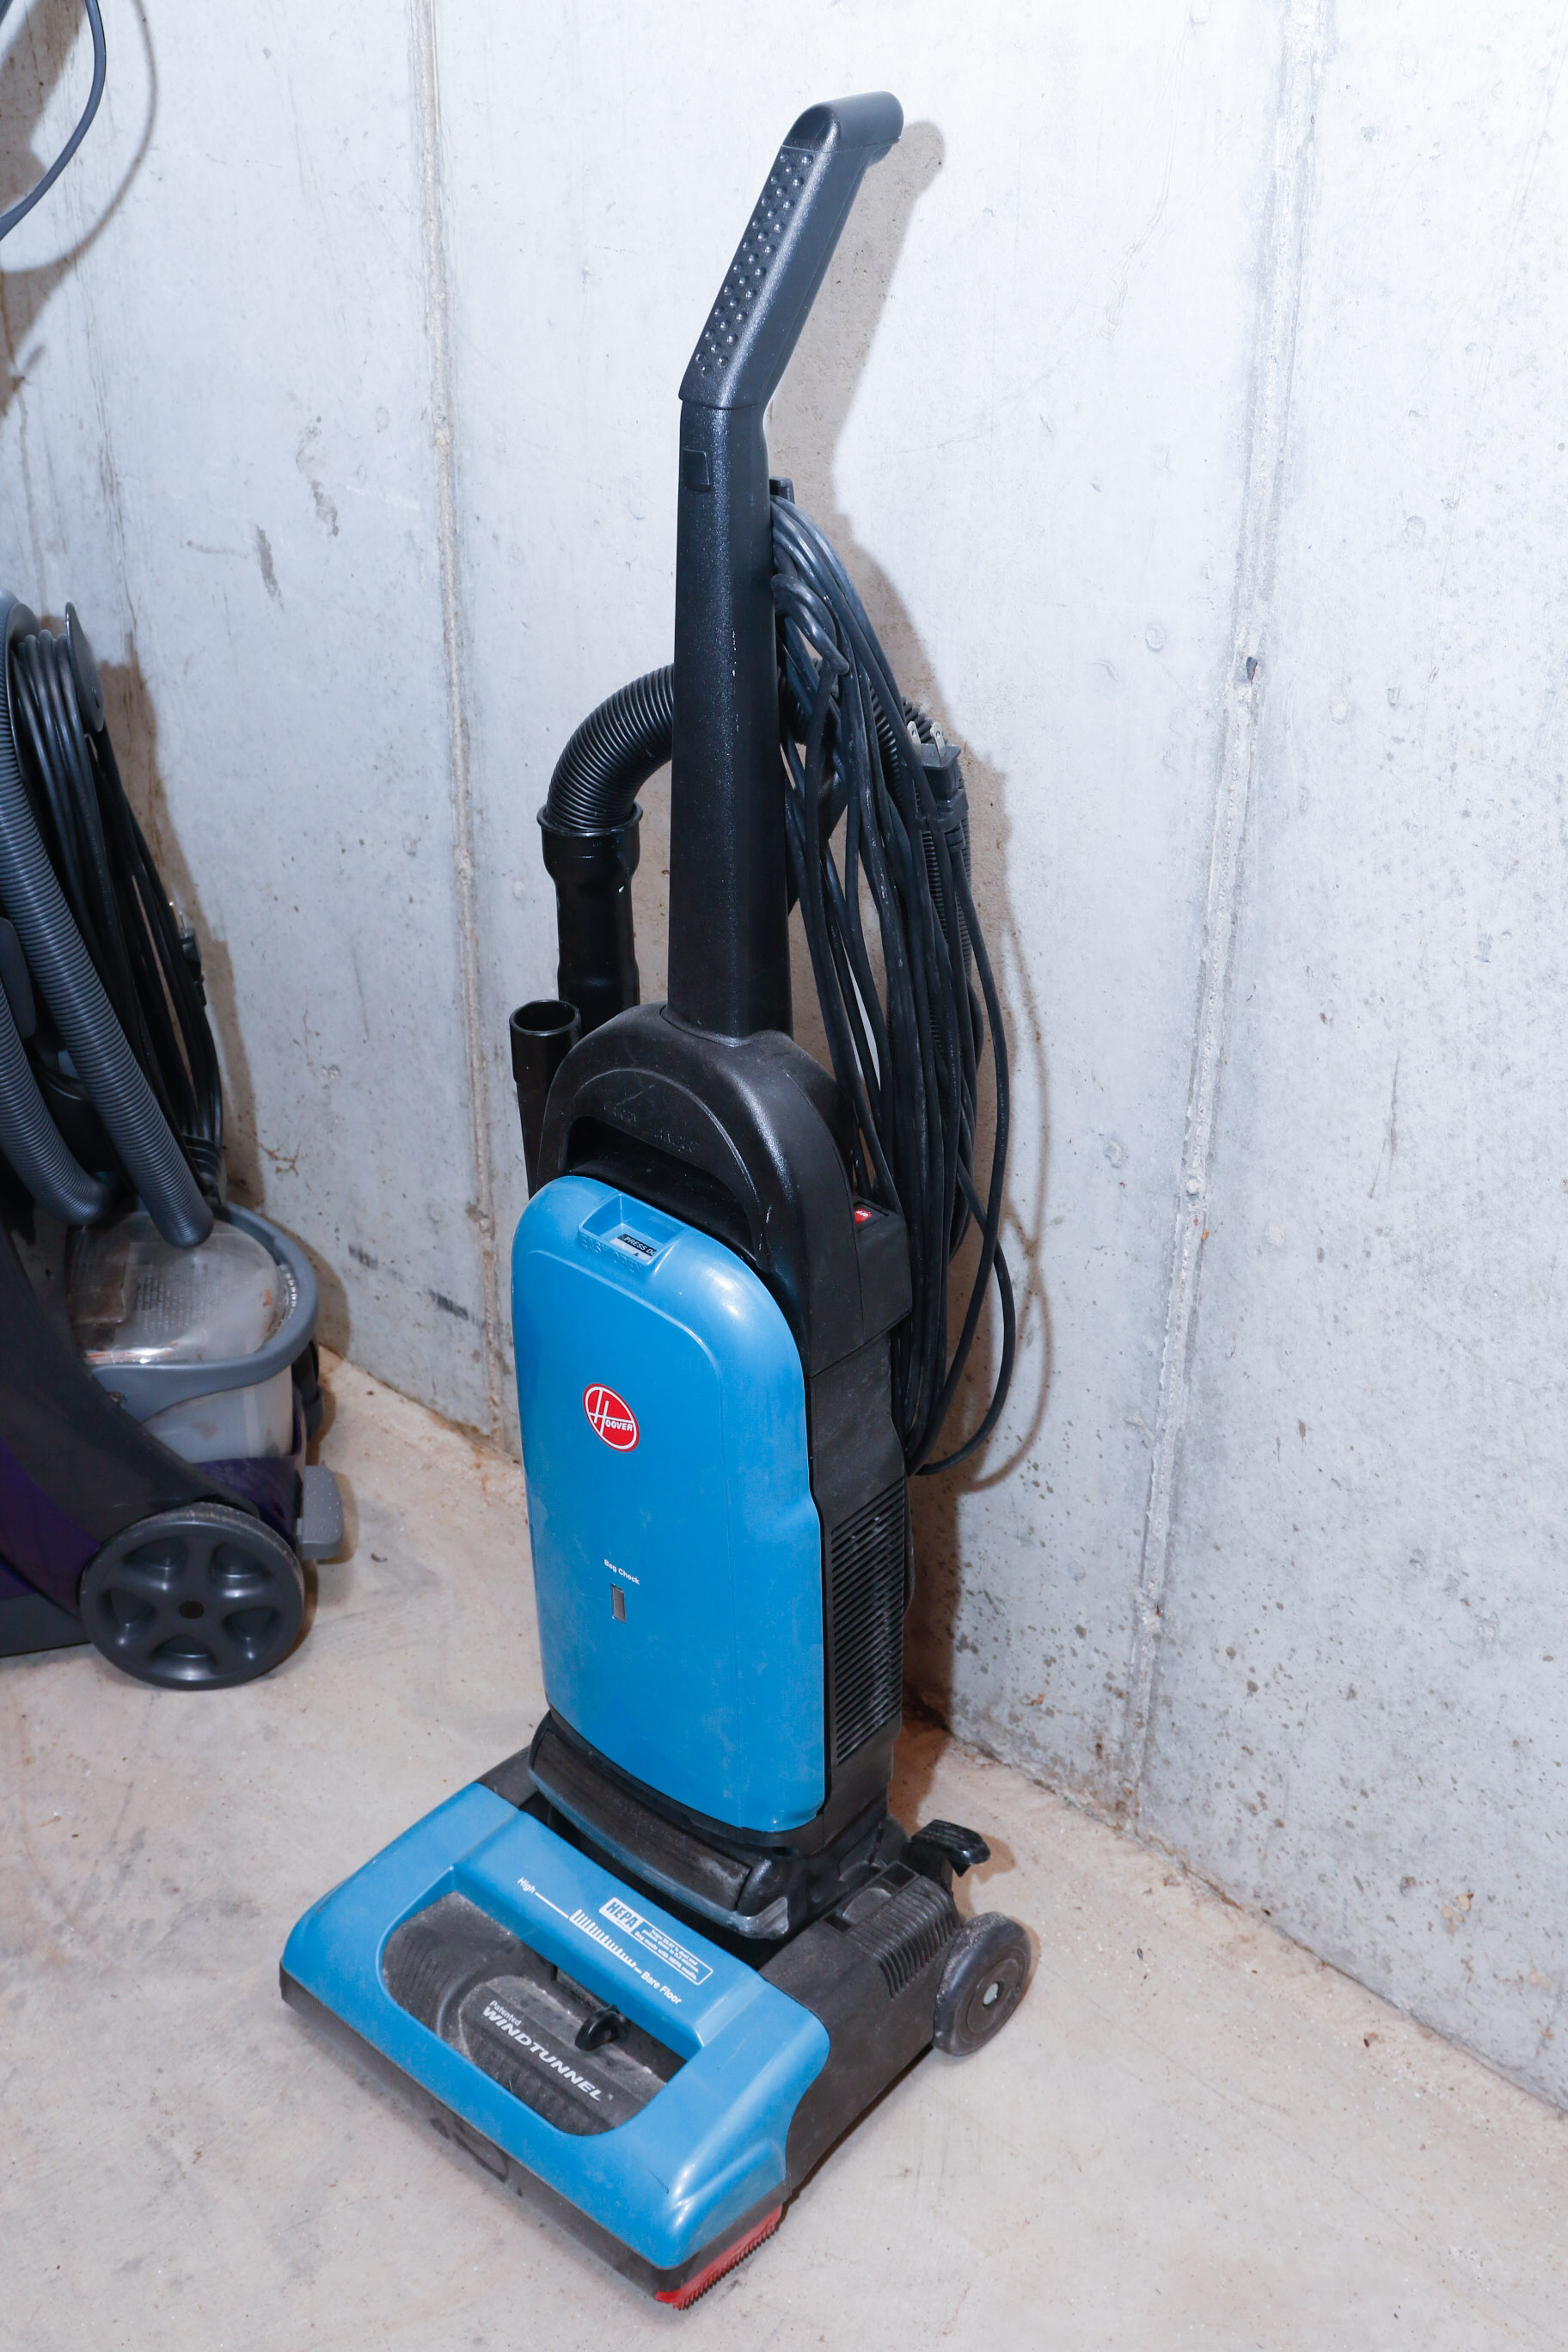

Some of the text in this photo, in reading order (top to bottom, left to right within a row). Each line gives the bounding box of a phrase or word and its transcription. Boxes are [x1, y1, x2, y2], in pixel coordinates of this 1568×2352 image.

[624, 1236, 647, 1251] PRESS
[588, 1389, 634, 1436] HOOVER
[603, 1558, 640, 1585] Bag Check
[517, 1877, 536, 1894] High
[606, 1901, 639, 1928] HEPA
[640, 1971, 682, 2005] Bare Floor
[489, 2000, 523, 2026] Patented
[482, 2006, 601, 2102] WINDTUNNEL
